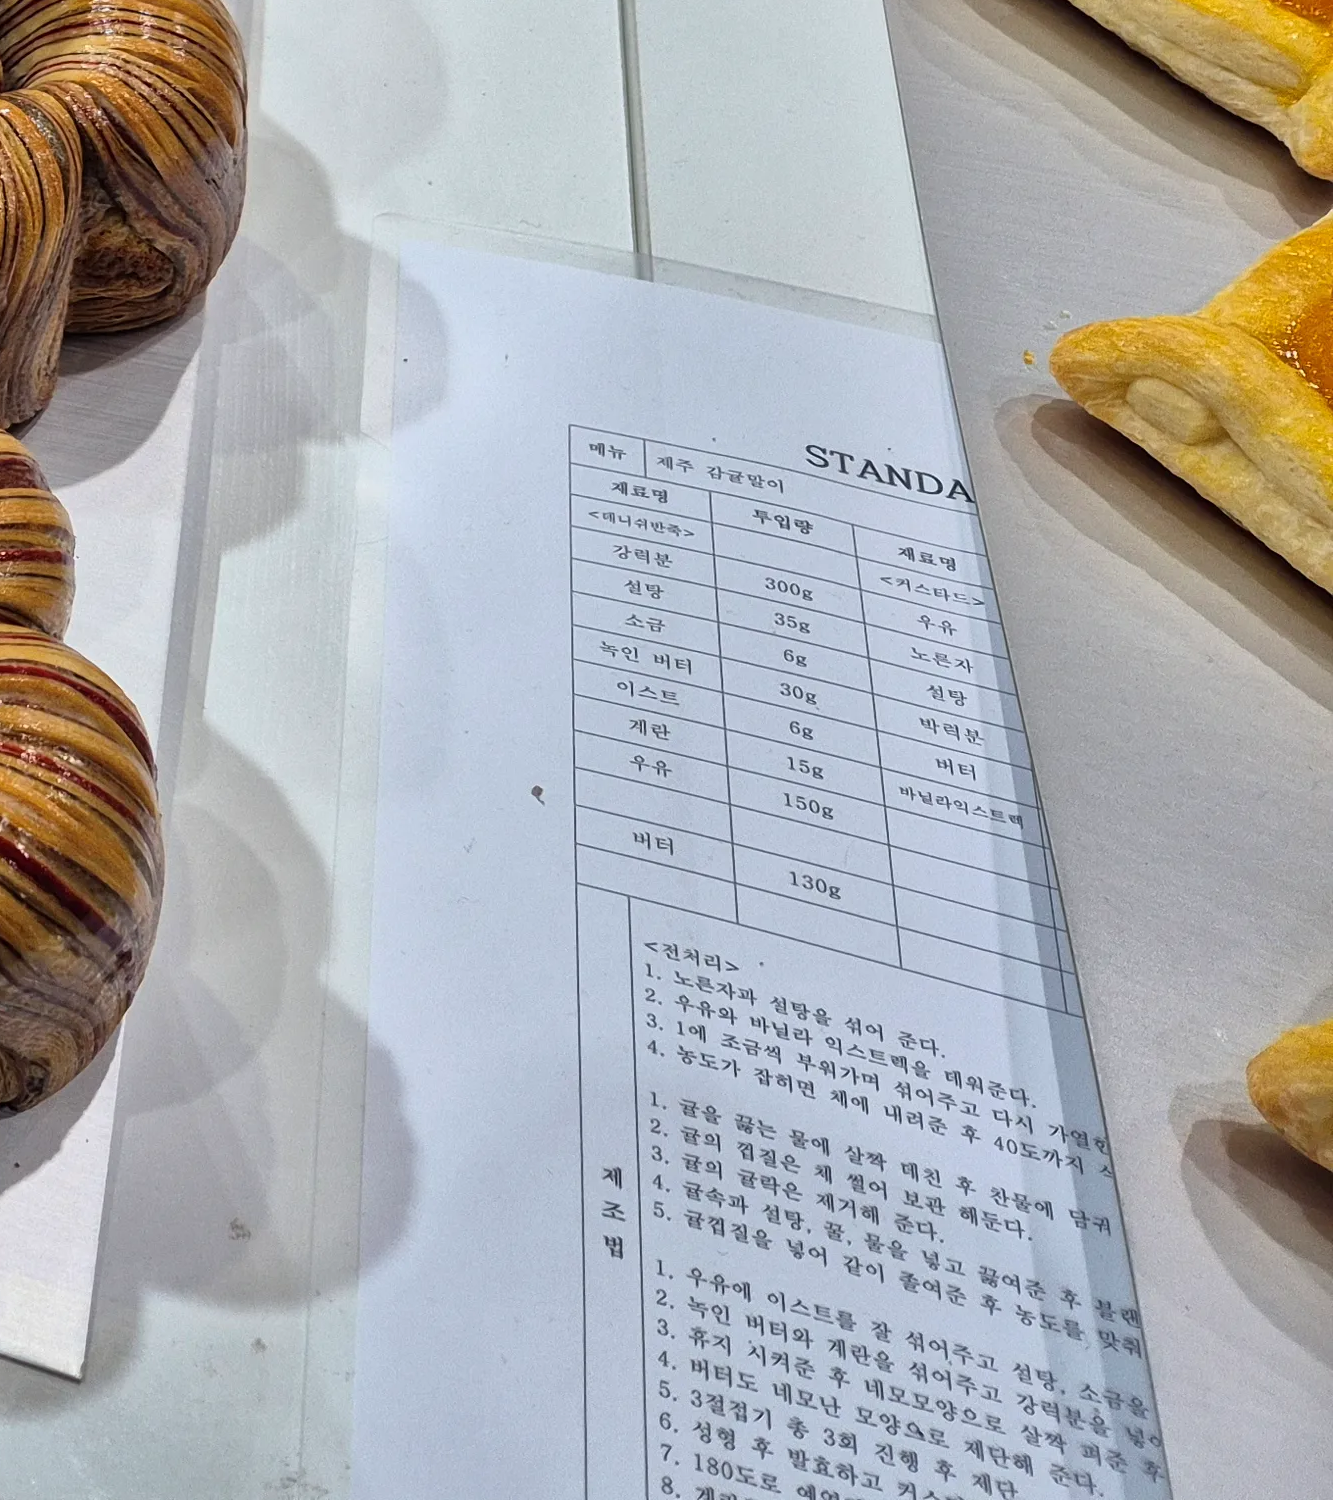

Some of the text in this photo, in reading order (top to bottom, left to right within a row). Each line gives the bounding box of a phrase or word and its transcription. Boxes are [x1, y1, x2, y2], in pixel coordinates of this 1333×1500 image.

[589, 442, 626, 461] 메뉴
[656, 456, 784, 494] 제주 감귤말이
[805, 444, 976, 503] STANDA
[611, 482, 668, 504] 재료명
[753, 510, 813, 535] 투입량
[613, 545, 673, 568] 강력분
[898, 547, 956, 572] 재료명
[624, 580, 664, 600] 설탕
[765, 577, 813, 601] 300g
[625, 614, 666, 633] 소금
[774, 613, 811, 634] 35g
[917, 615, 957, 636] 우유
[600, 641, 692, 675] 녹인 버터
[783, 649, 807, 667] 6g
[910, 647, 974, 674] 노른자
[616, 681, 680, 705] 이스트
[779, 683, 817, 705] 30g
[926, 685, 968, 707] 설탕
[629, 719, 670, 740] 계란
[789, 721, 813, 740] 6g
[919, 717, 984, 746] 박력분
[629, 755, 673, 778] 우유
[787, 756, 824, 780] 15g
[935, 758, 977, 781] 버터
[783, 792, 834, 820] 150g
[633, 832, 674, 856] 버터
[789, 871, 841, 900] 130g
[644, 941, 739, 972] <전처리>
[646, 963, 945, 1059] 1. 노른자과 설탕을 섞어 준다.
[645, 988, 662, 1004] 2.
[675, 995, 737, 1025] 우유와
[751, 1016, 812, 1047] 바닐라
[944, 1070, 1036, 1108] 데워준다.
[647, 1013, 663, 1030] 3.
[677, 1021, 706, 1043] 1에
[721, 1033, 781, 1063] 조금씩
[895, 1080, 980, 1118] 섞어주고
[992, 1109, 1033, 1134] 다시
[648, 1040, 664, 1056] 4.
[677, 1045, 740, 1077] 농도가
[754, 1068, 816, 1099] 잡히면
[884, 1105, 948, 1136] 내려준
[961, 1125, 981, 1144] 후
[994, 1137, 1083, 1175] 40도까지
[650, 1092, 667, 1109] 1.
[679, 1099, 721, 1125] 귤을
[735, 1114, 777, 1140] 끓는
[789, 1129, 829, 1157] 물에
[844, 1145, 887, 1172] 살짝
[956, 1176, 976, 1196] 후
[990, 1187, 1054, 1220] 찬물에
[650, 1119, 668, 1137] 2.
[681, 1126, 720, 1152] 귤의
[737, 1141, 800, 1174] 껍질은
[847, 1174, 887, 1200] 썰어
[903, 1190, 945, 1216] 보관
[959, 1206, 1032, 1241] 해둔다.
[652, 1146, 944, 1243] 3. 귤의 귤락은 제거해 준다.
[653, 1175, 670, 1193] 4.
[683, 1182, 748, 1215] 귤속과
[864, 1232, 908, 1261] 물을
[922, 1250, 966, 1276] 넣고
[978, 1266, 1046, 1301] 끓여준
[1060, 1289, 1081, 1309] 후
[654, 1202, 671, 1221] 5.
[684, 1210, 772, 1250] 귤껍질을
[786, 1239, 827, 1267] 넣어
[844, 1256, 884, 1284] 같이
[980, 1294, 1001, 1315] 후
[1015, 1305, 1084, 1341] 농도를
[656, 1260, 673, 1279] 1.
[687, 1267, 751, 1302] 우유에
[768, 1292, 857, 1331] 이스트를
[871, 1320, 891, 1343] 잘
[906, 1330, 998, 1372] 섞어주고
[1080, 1383, 1149, 1420] 소금을
[656, 1289, 674, 1309] 2.
[688, 1296, 730, 1326] 녹인
[746, 1315, 813, 1350] 버터와
[829, 1338, 894, 1372] 계란을
[909, 1361, 1002, 1404] 섞어주고
[1017, 1393, 1110, 1437] 강력분을
[657, 1319, 675, 1339] 3.
[689, 1326, 731, 1356] 휴지
[748, 1345, 815, 1380] 시켜준
[829, 1367, 850, 1388] 후
[865, 1378, 1007, 1435] 네모모양으로
[1021, 1425, 1067, 1455] 살짝
[1142, 1459, 1164, 1483] 후
[658, 1351, 676, 1370] 4.
[691, 1358, 758, 1392] 버터도
[773, 1382, 841, 1417] 네모난
[855, 1406, 950, 1449] 모양으로
[1049, 1462, 1104, 1497] 준다.
[659, 1381, 677, 1401] 5.
[787, 1417, 809, 1439] 총
[824, 1428, 857, 1455] 3회
[875, 1443, 918, 1472] 진행
[934, 1458, 956, 1483] 후
[660, 1412, 678, 1433] 6.
[693, 1420, 735, 1450] 성형
[751, 1437, 773, 1460] 후
[788, 1448, 883, 1491] 발효하고
[661, 1444, 679, 1465] 7.
[694, 1452, 781, 1494] 180도로
[662, 1476, 680, 1498] 8.
